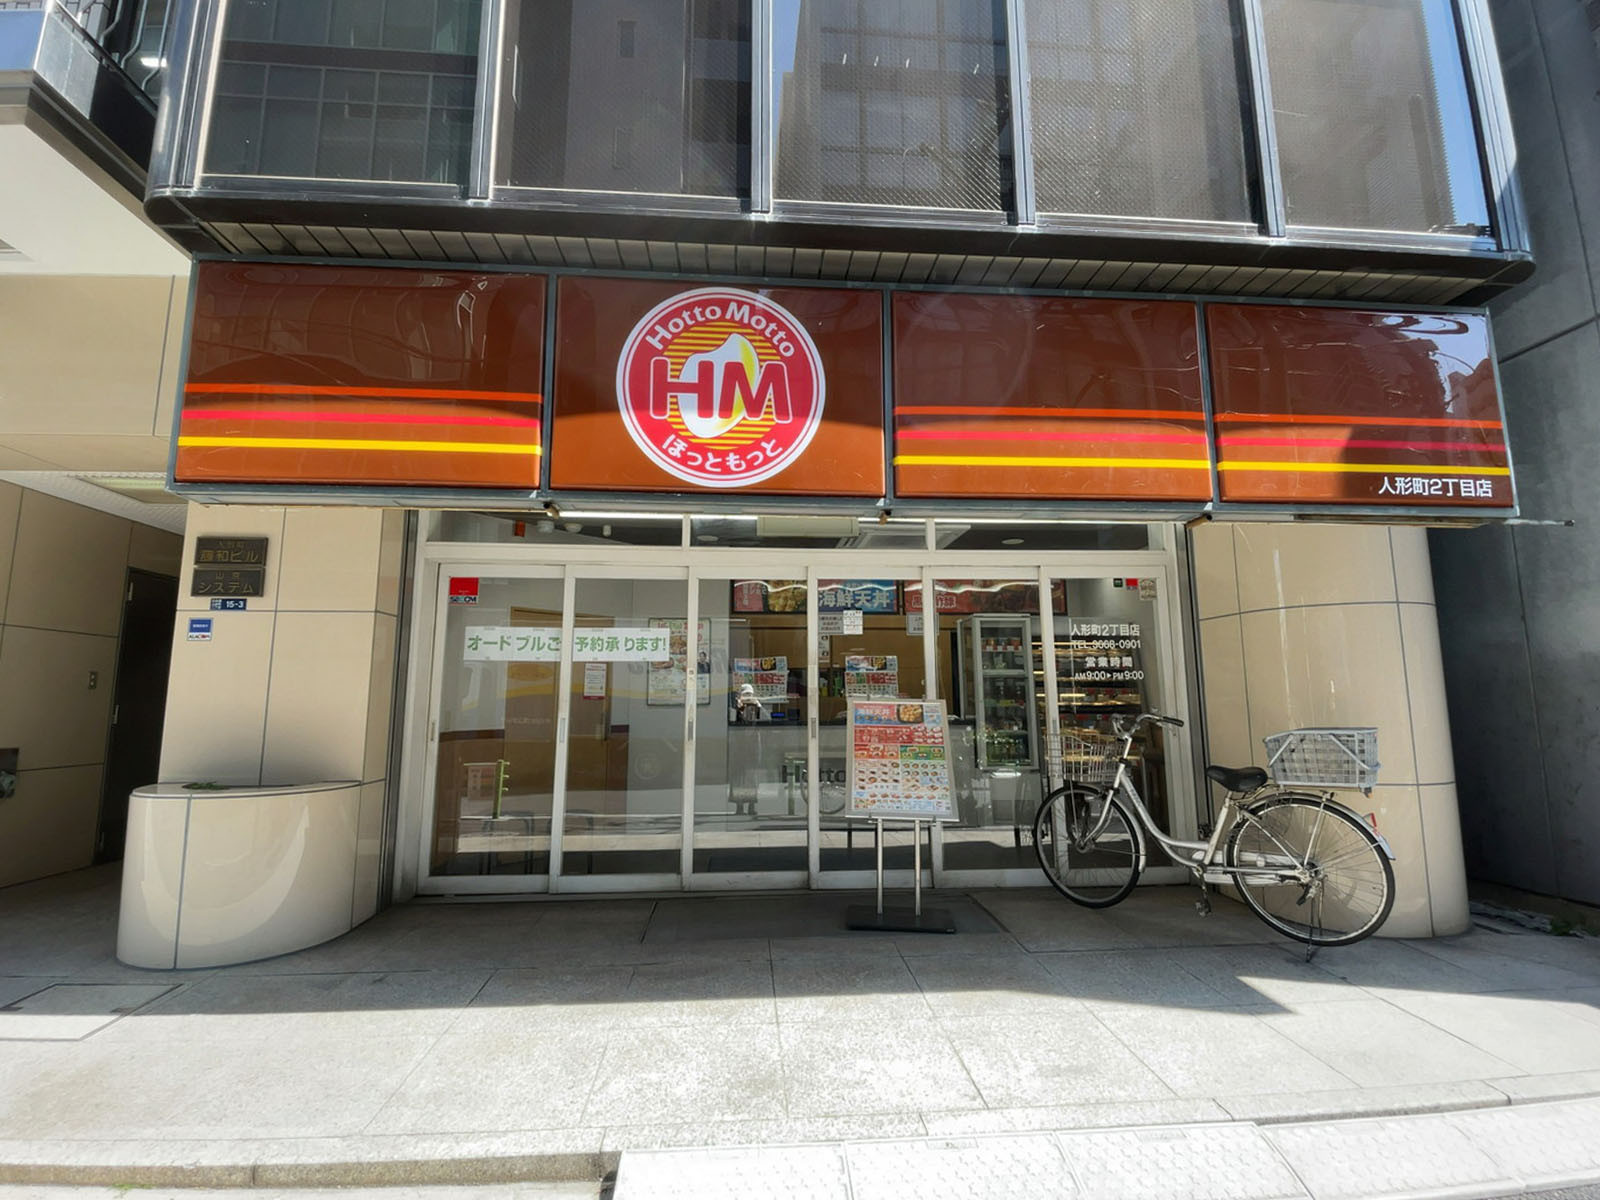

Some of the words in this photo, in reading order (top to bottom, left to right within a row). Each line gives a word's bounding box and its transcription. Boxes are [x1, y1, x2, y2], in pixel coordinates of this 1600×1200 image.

[645, 305, 722, 350] Hotto
[724, 301, 796, 358] Motto
[650, 356, 793, 424] HM
[661, 433, 783, 473] ほっともっと
[1378, 476, 1493, 498] 人形町2丁目店
[198, 582, 254, 594] システム
[1070, 623, 1141, 637] 人形町2丁目店
